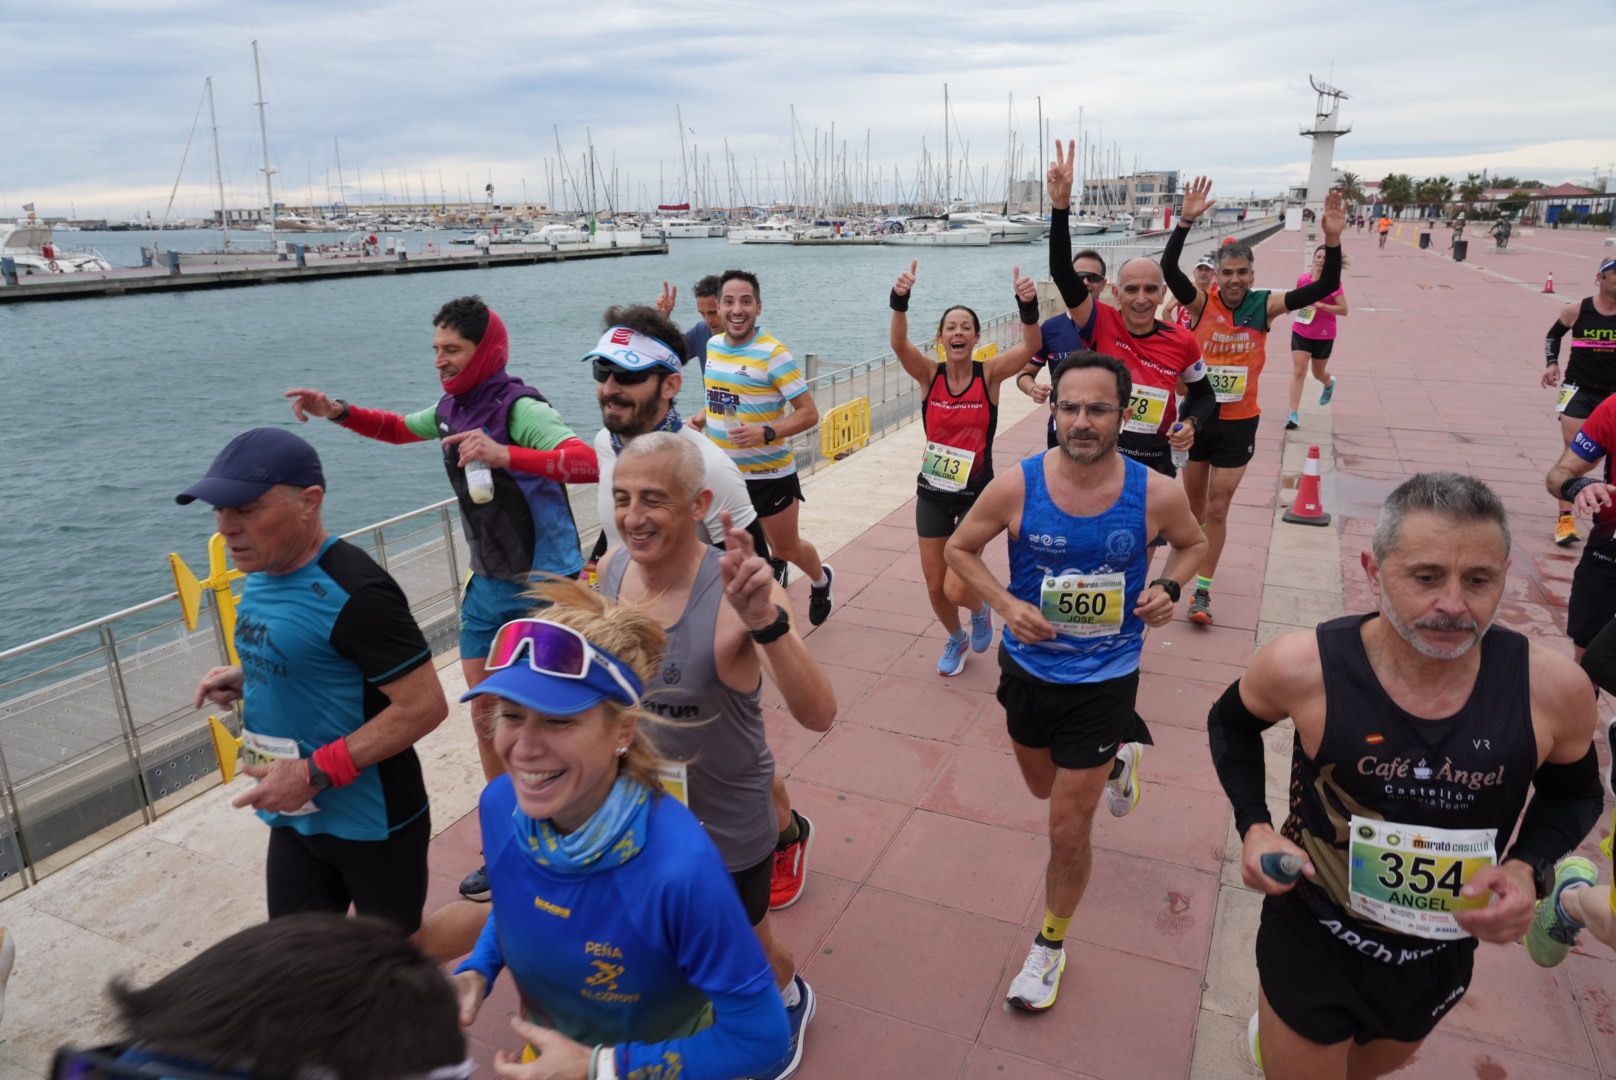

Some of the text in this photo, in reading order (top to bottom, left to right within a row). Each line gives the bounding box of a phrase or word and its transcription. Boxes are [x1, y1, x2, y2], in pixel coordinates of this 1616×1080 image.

[1212, 375, 1238, 388] 337
[1130, 396, 1149, 414] 78
[932, 454, 960, 475] 713
[1058, 592, 1107, 616] 560
[1066, 615, 1095, 625] JOSE
[1473, 738, 1491, 750] VR
[1357, 755, 1411, 781] Café
[1378, 852, 1464, 898] 354
[1388, 891, 1451, 912] ANGEL
